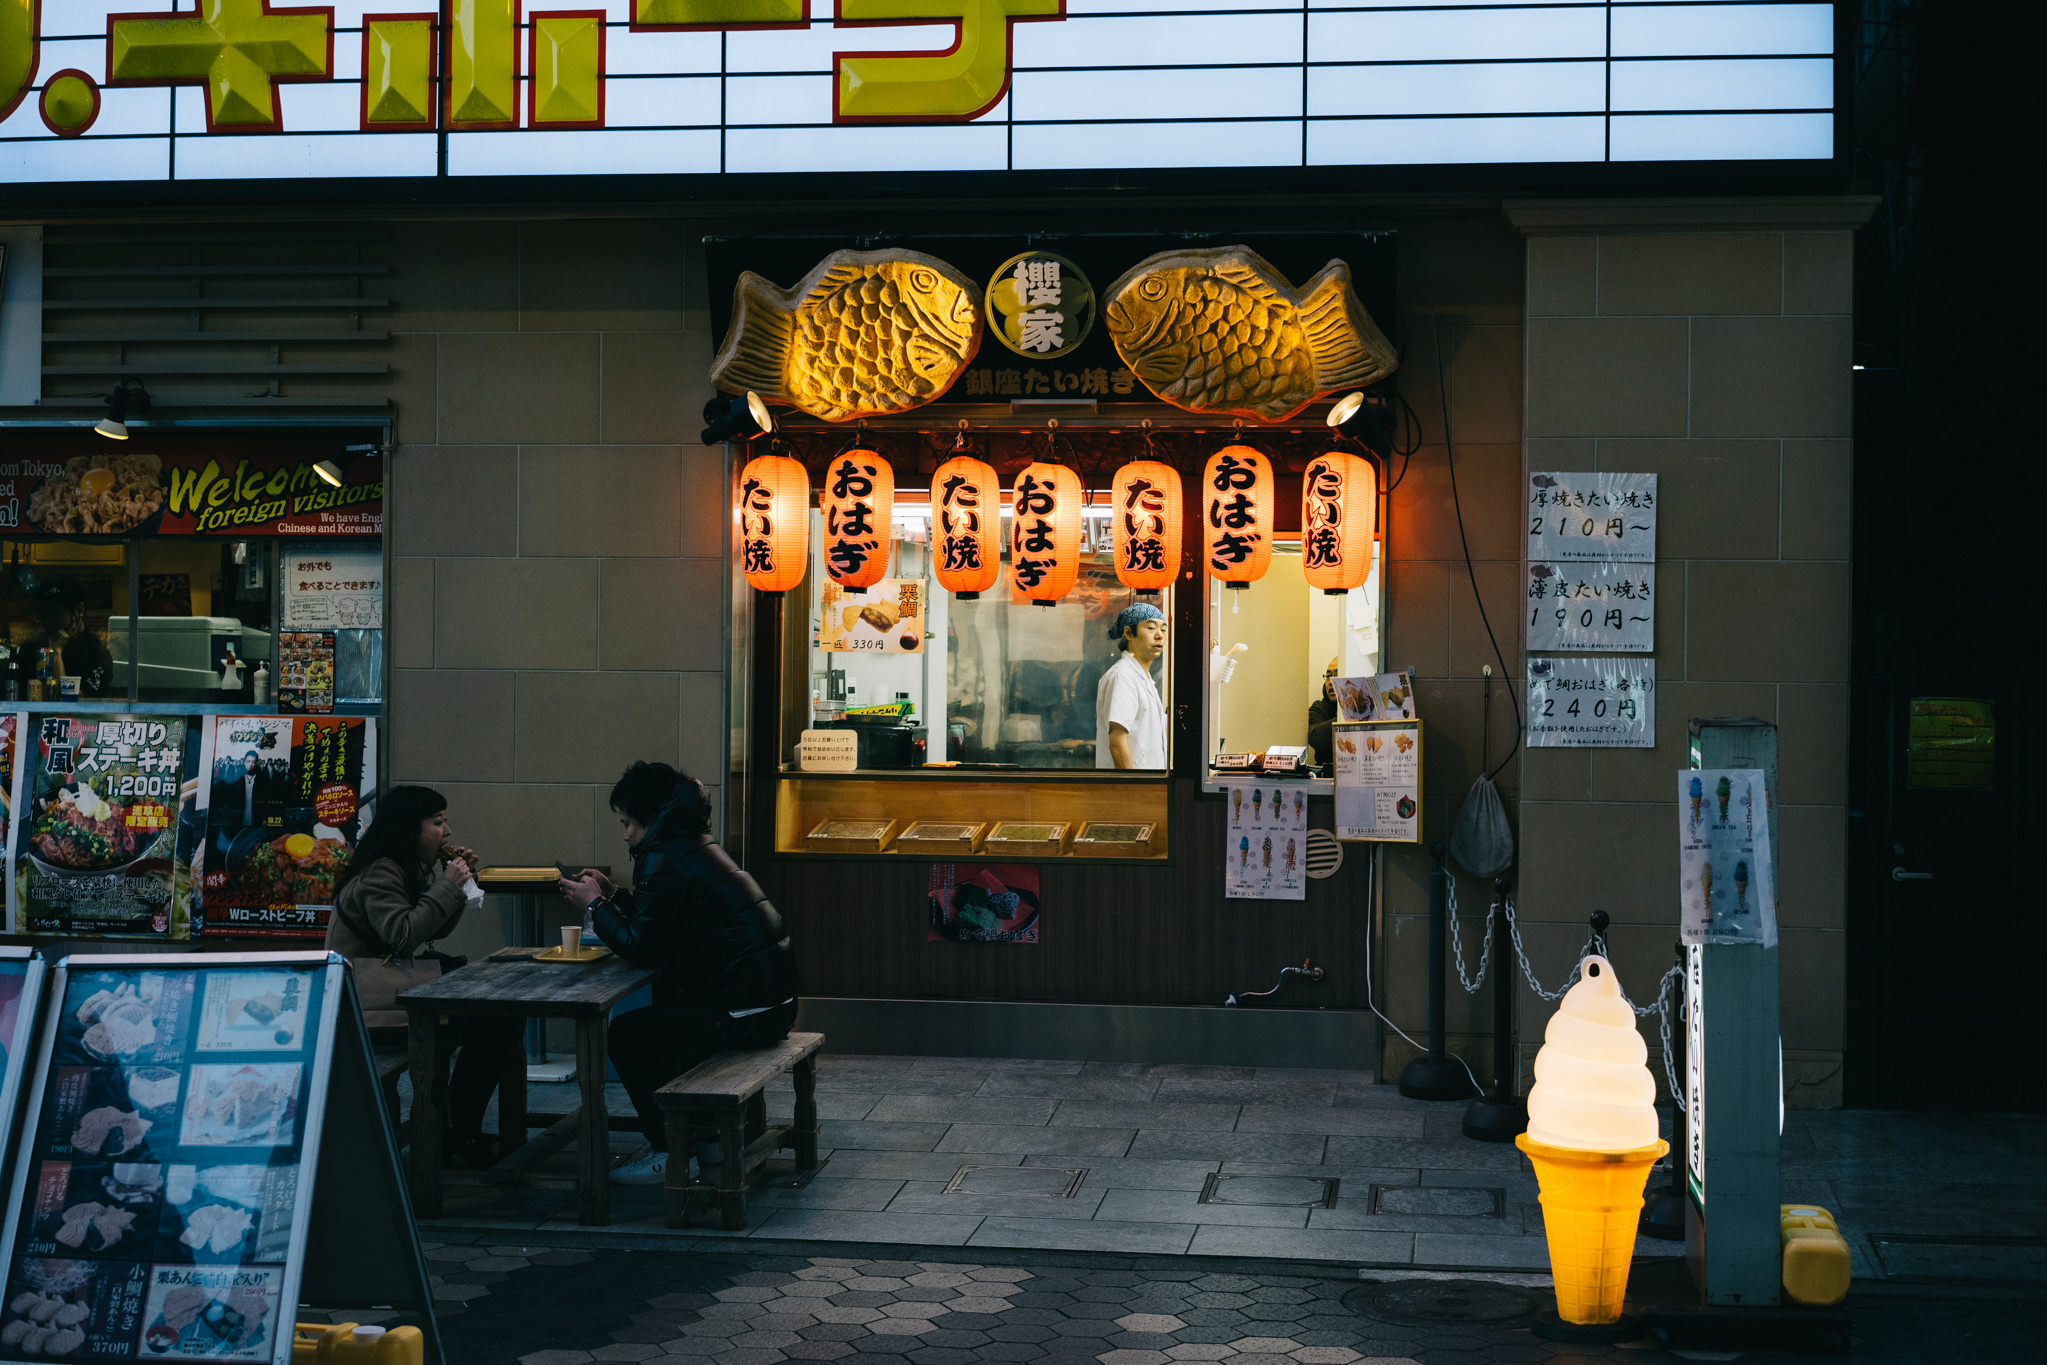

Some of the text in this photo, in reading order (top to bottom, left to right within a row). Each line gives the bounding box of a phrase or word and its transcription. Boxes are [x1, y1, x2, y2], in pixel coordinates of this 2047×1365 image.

[1012, 260, 1065, 352] 櫻家
[21, 459, 65, 478] Tokyo,
[168, 458, 331, 513] Welcom
[195, 480, 384, 532] foreign visitors
[320, 513, 335, 523] We
[336, 513, 360, 523] have
[742, 476, 776, 572] たい焼
[828, 459, 879, 579] おはぎ
[941, 474, 983, 572] たい焼
[1124, 477, 1167, 572] たい焼
[1209, 455, 1261, 571] おはぎ
[1303, 461, 1342, 569] たい焼
[1530, 489, 1654, 509] 厚焼きたい焼き
[277, 523, 316, 534] Chinese
[318, 523, 336, 533] and
[337, 523, 373, 534] Korean
[1014, 475, 1057, 592] おはぎ
[1528, 577, 1651, 601] 薄皮たい焼き
[96, 721, 166, 747] 厚切り
[1543, 698, 1637, 720] 240円
[1914, 726, 1974, 737] Authorized
[42, 717, 75, 775] 和風
[77, 747, 181, 774] ステーキ丼
[106, 775, 177, 797] 1,200円
[229, 907, 316, 923] Wローストビーフ丼
[120, 1263, 146, 1331] 小鯛焼き
